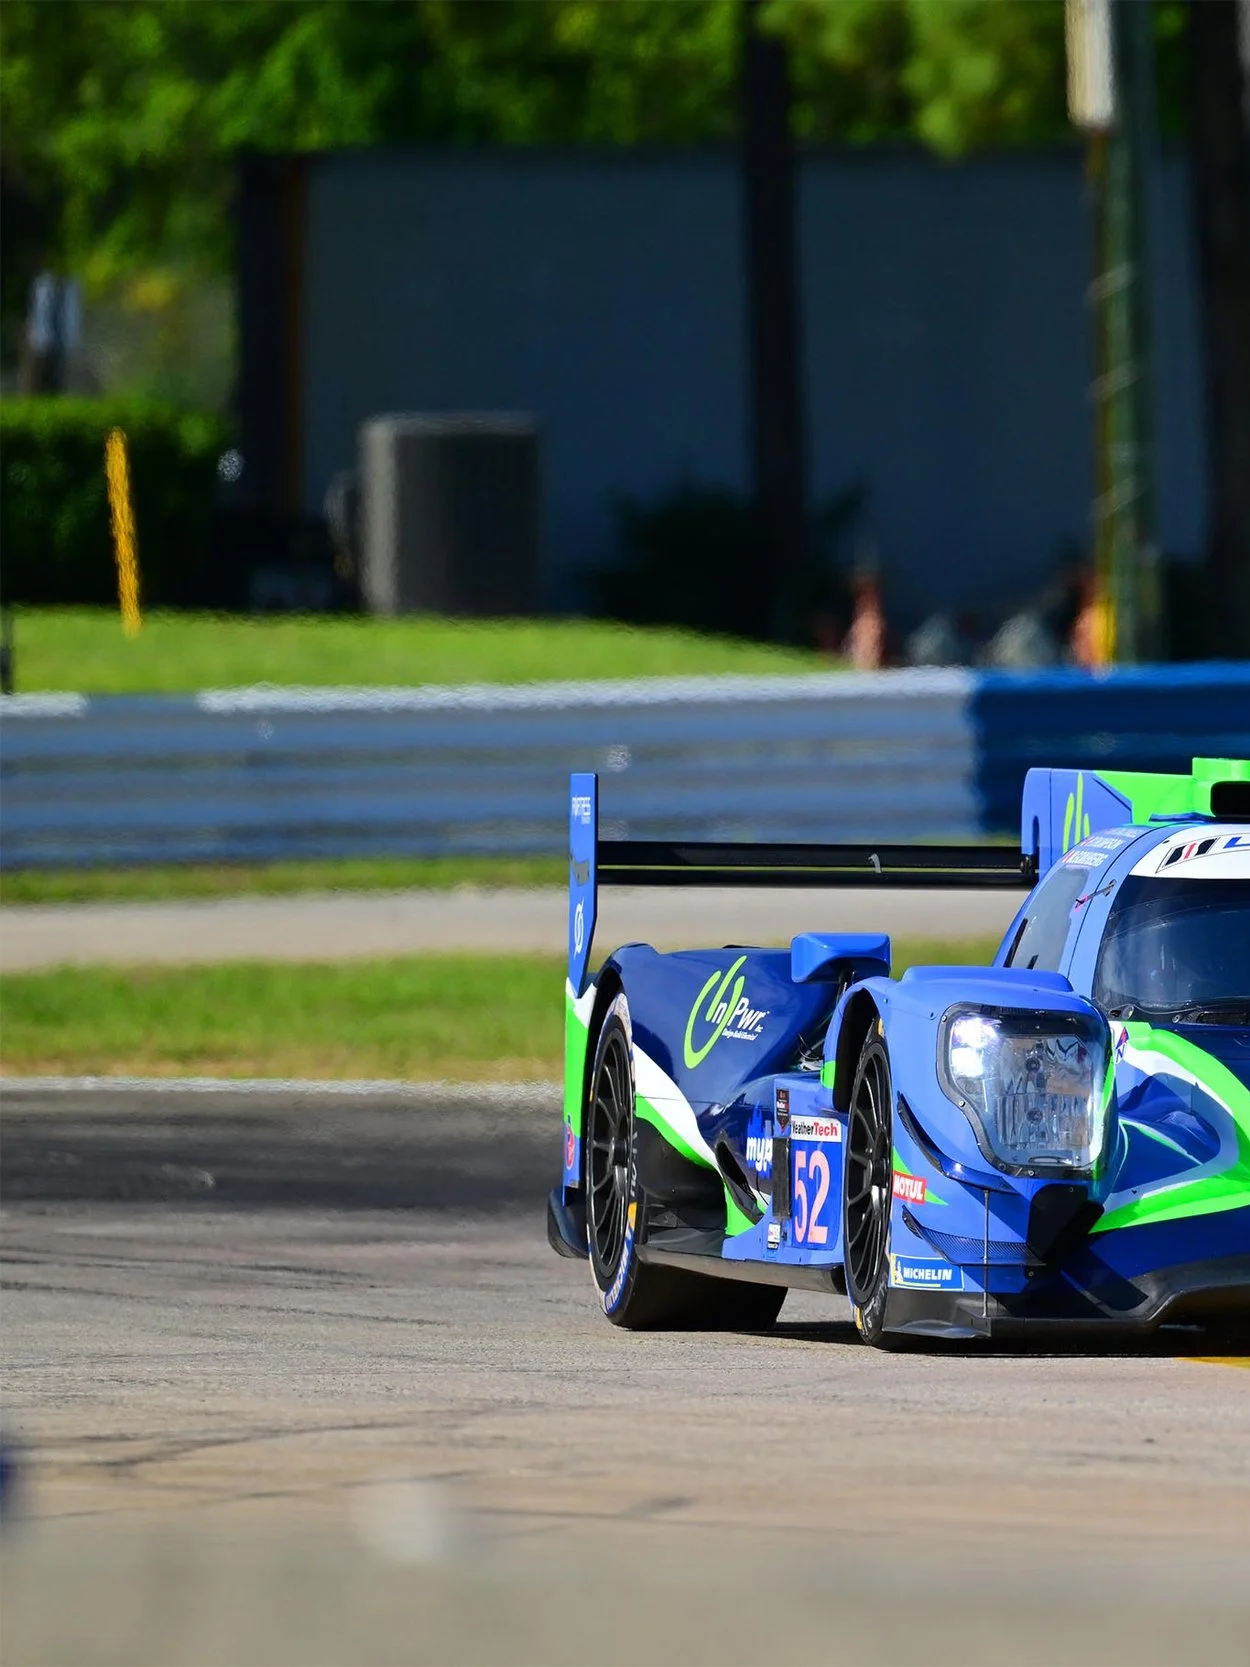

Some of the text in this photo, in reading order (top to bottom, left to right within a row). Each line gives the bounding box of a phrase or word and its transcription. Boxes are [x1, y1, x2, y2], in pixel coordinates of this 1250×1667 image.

[794, 1150, 830, 1244] 52
[893, 1175, 924, 1200] MOTUL
[903, 1266, 953, 1281] MICHELIN
